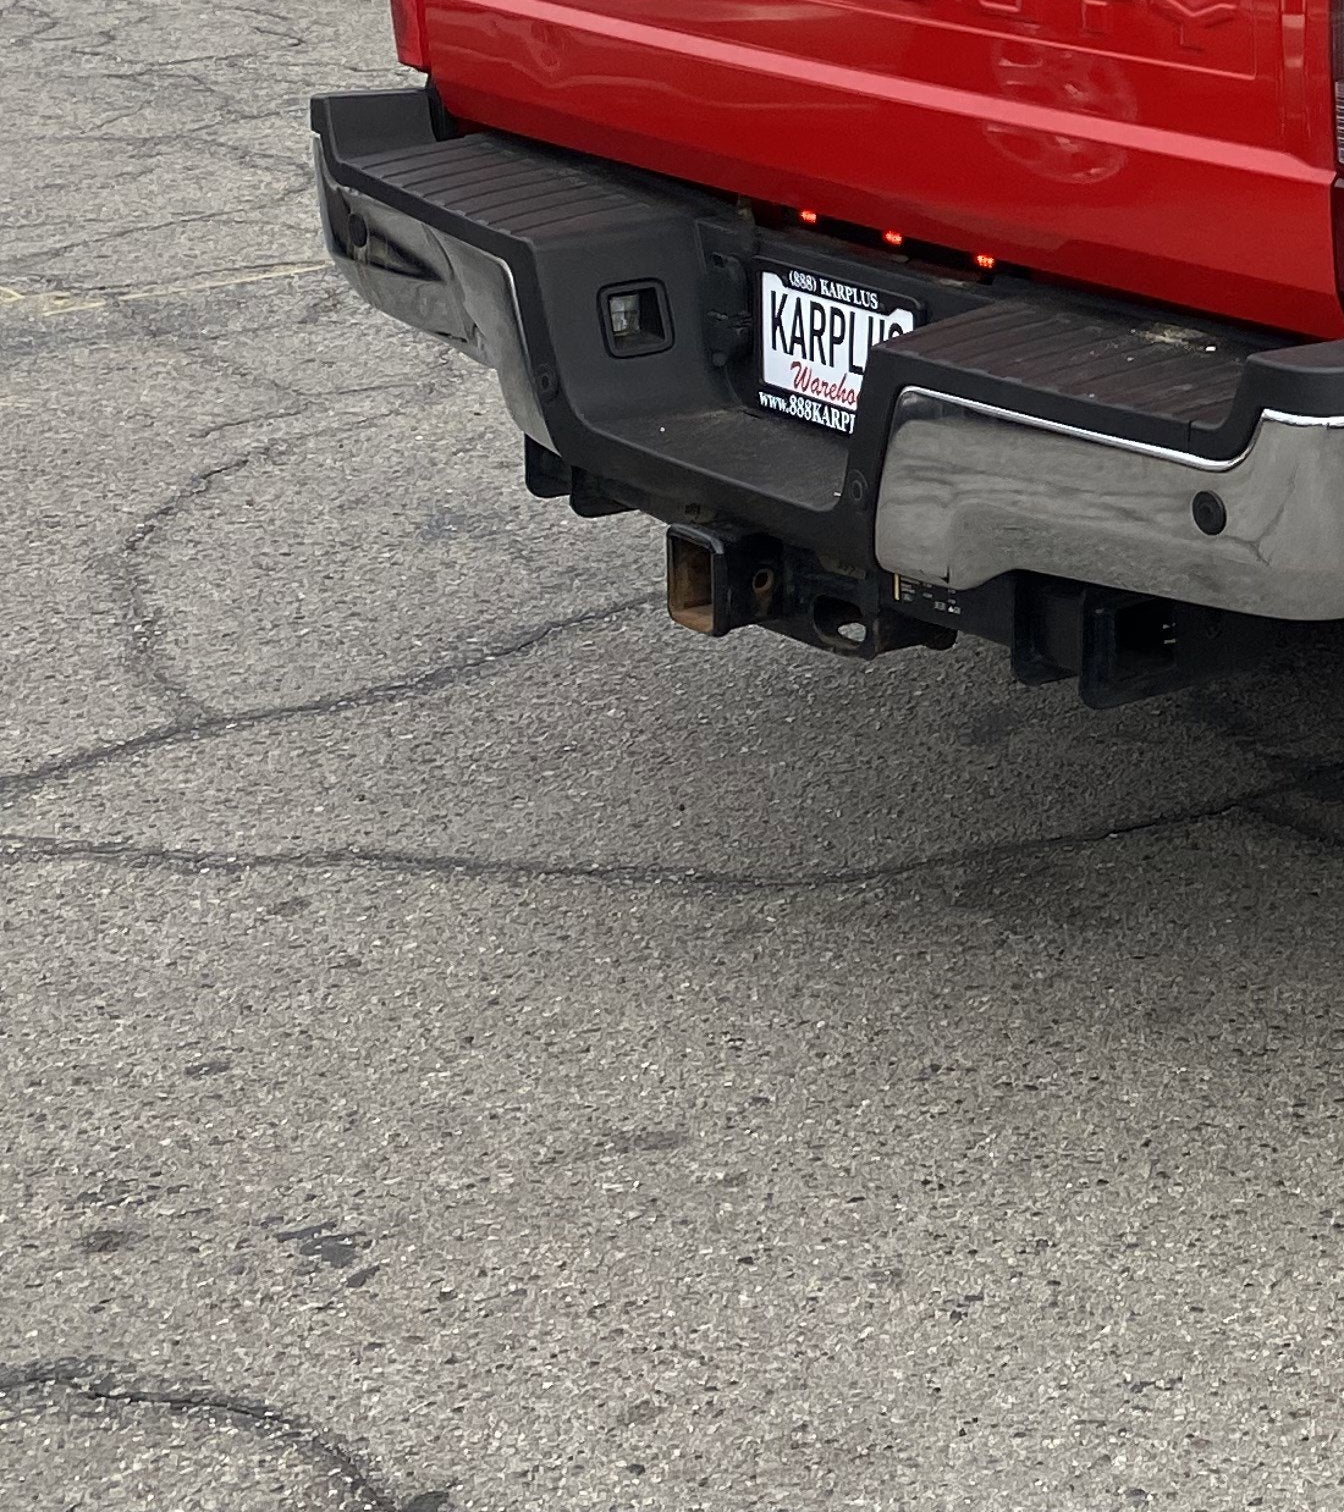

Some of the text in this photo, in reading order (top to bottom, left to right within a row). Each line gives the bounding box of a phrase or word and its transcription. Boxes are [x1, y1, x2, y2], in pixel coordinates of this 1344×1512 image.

[789, 270, 879, 310] (888) KARPLUS
[790, 361, 860, 406] Wareho
